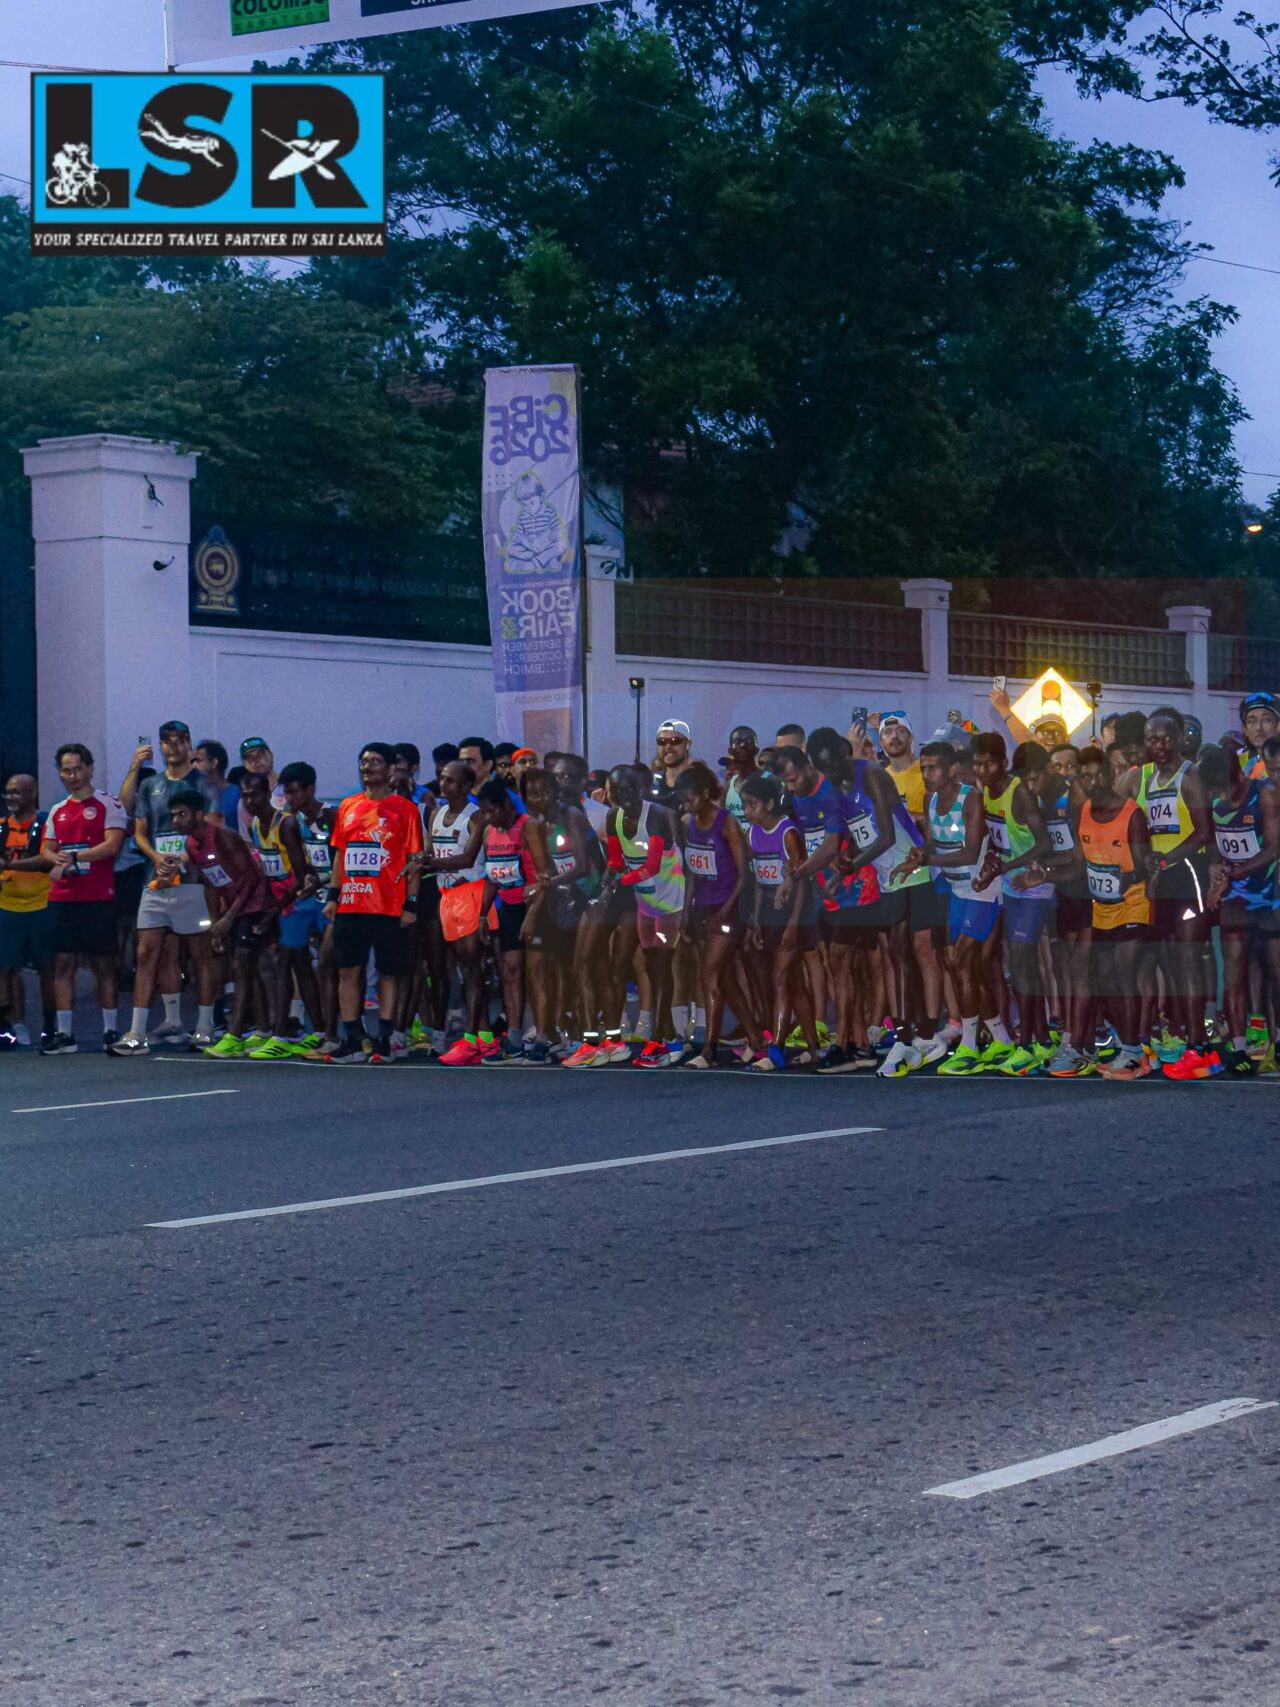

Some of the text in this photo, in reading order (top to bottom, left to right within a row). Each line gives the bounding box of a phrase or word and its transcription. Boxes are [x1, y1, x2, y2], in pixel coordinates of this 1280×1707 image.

[1150, 803, 1172, 820] 074
[160, 840, 182, 852] 479
[1222, 838, 1249, 854] 091
[346, 853, 378, 865] 1128
[689, 855, 710, 869] 661
[757, 866, 778, 878] 662
[1090, 876, 1113, 894] 073
